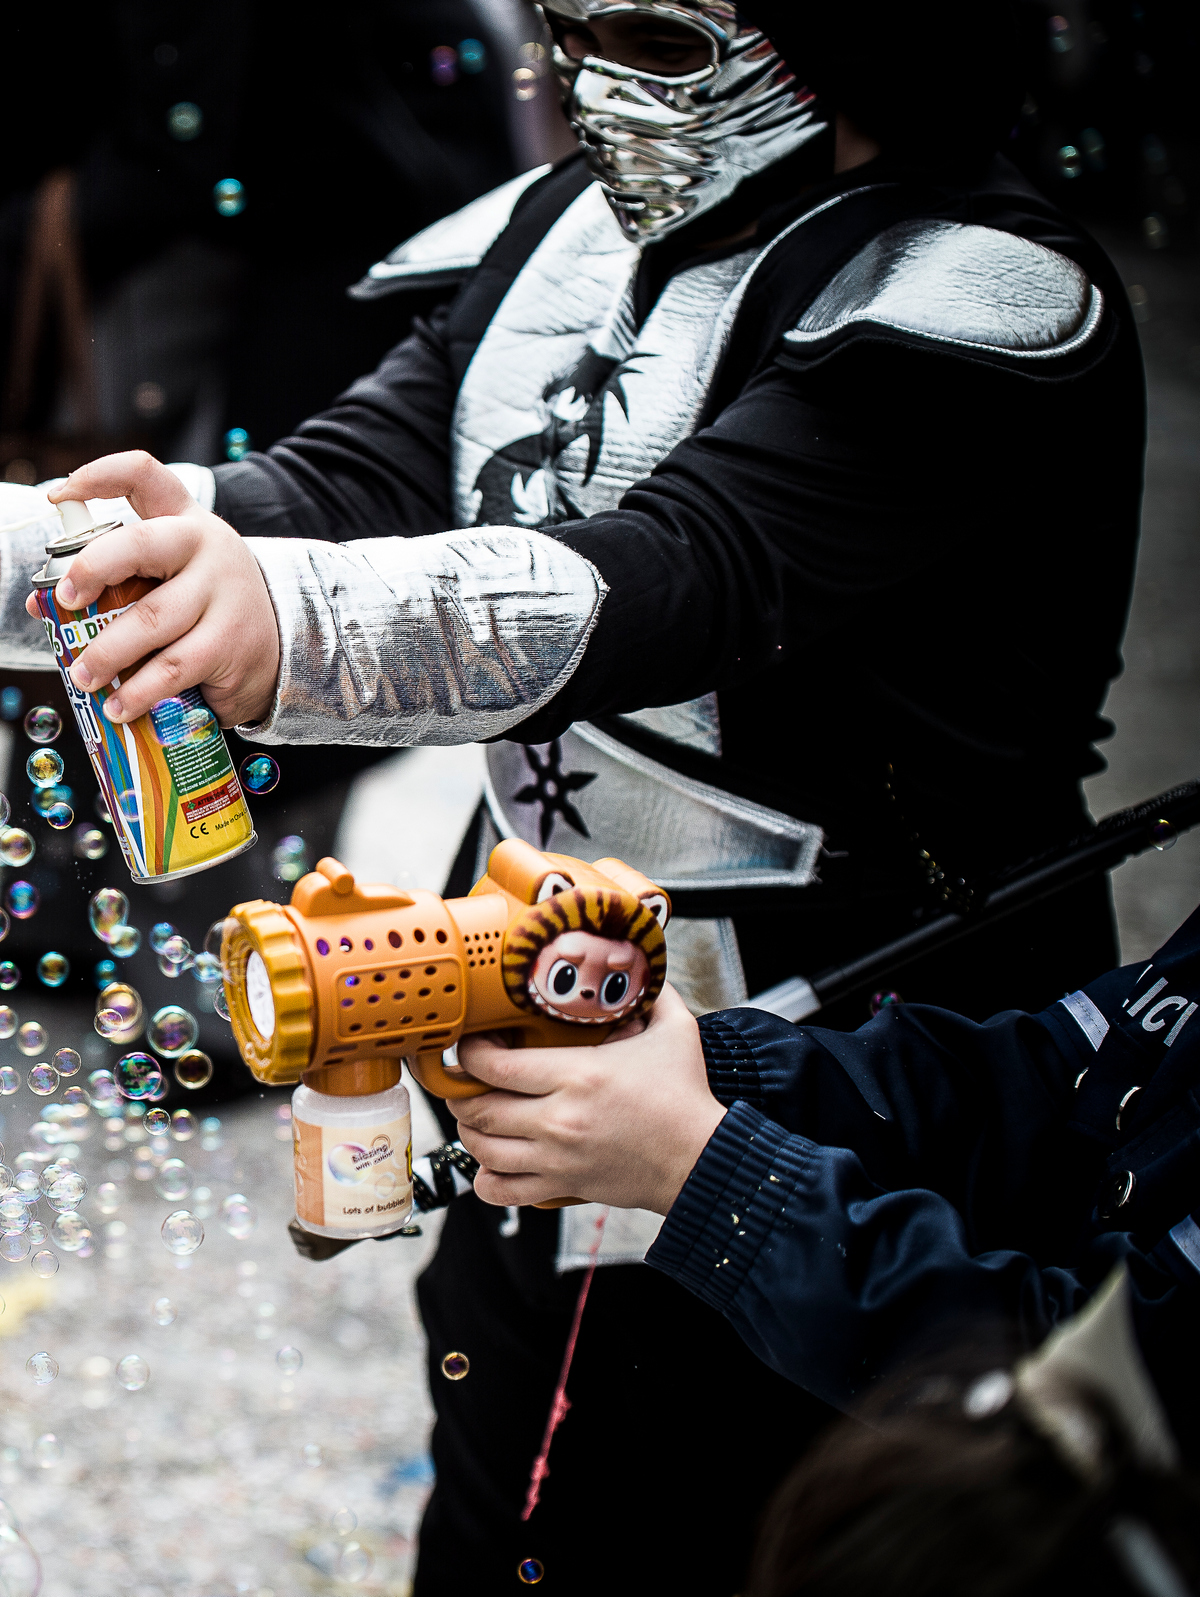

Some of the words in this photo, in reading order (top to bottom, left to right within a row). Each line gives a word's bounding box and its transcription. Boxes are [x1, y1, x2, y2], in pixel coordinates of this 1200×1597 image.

[64, 625, 82, 645] Di
[190, 822, 209, 838] CE
[215, 820, 230, 831] Made
[343, 1207, 361, 1215] Lots
[365, 1205, 374, 1214] of
[376, 1197, 405, 1212] bubbles
